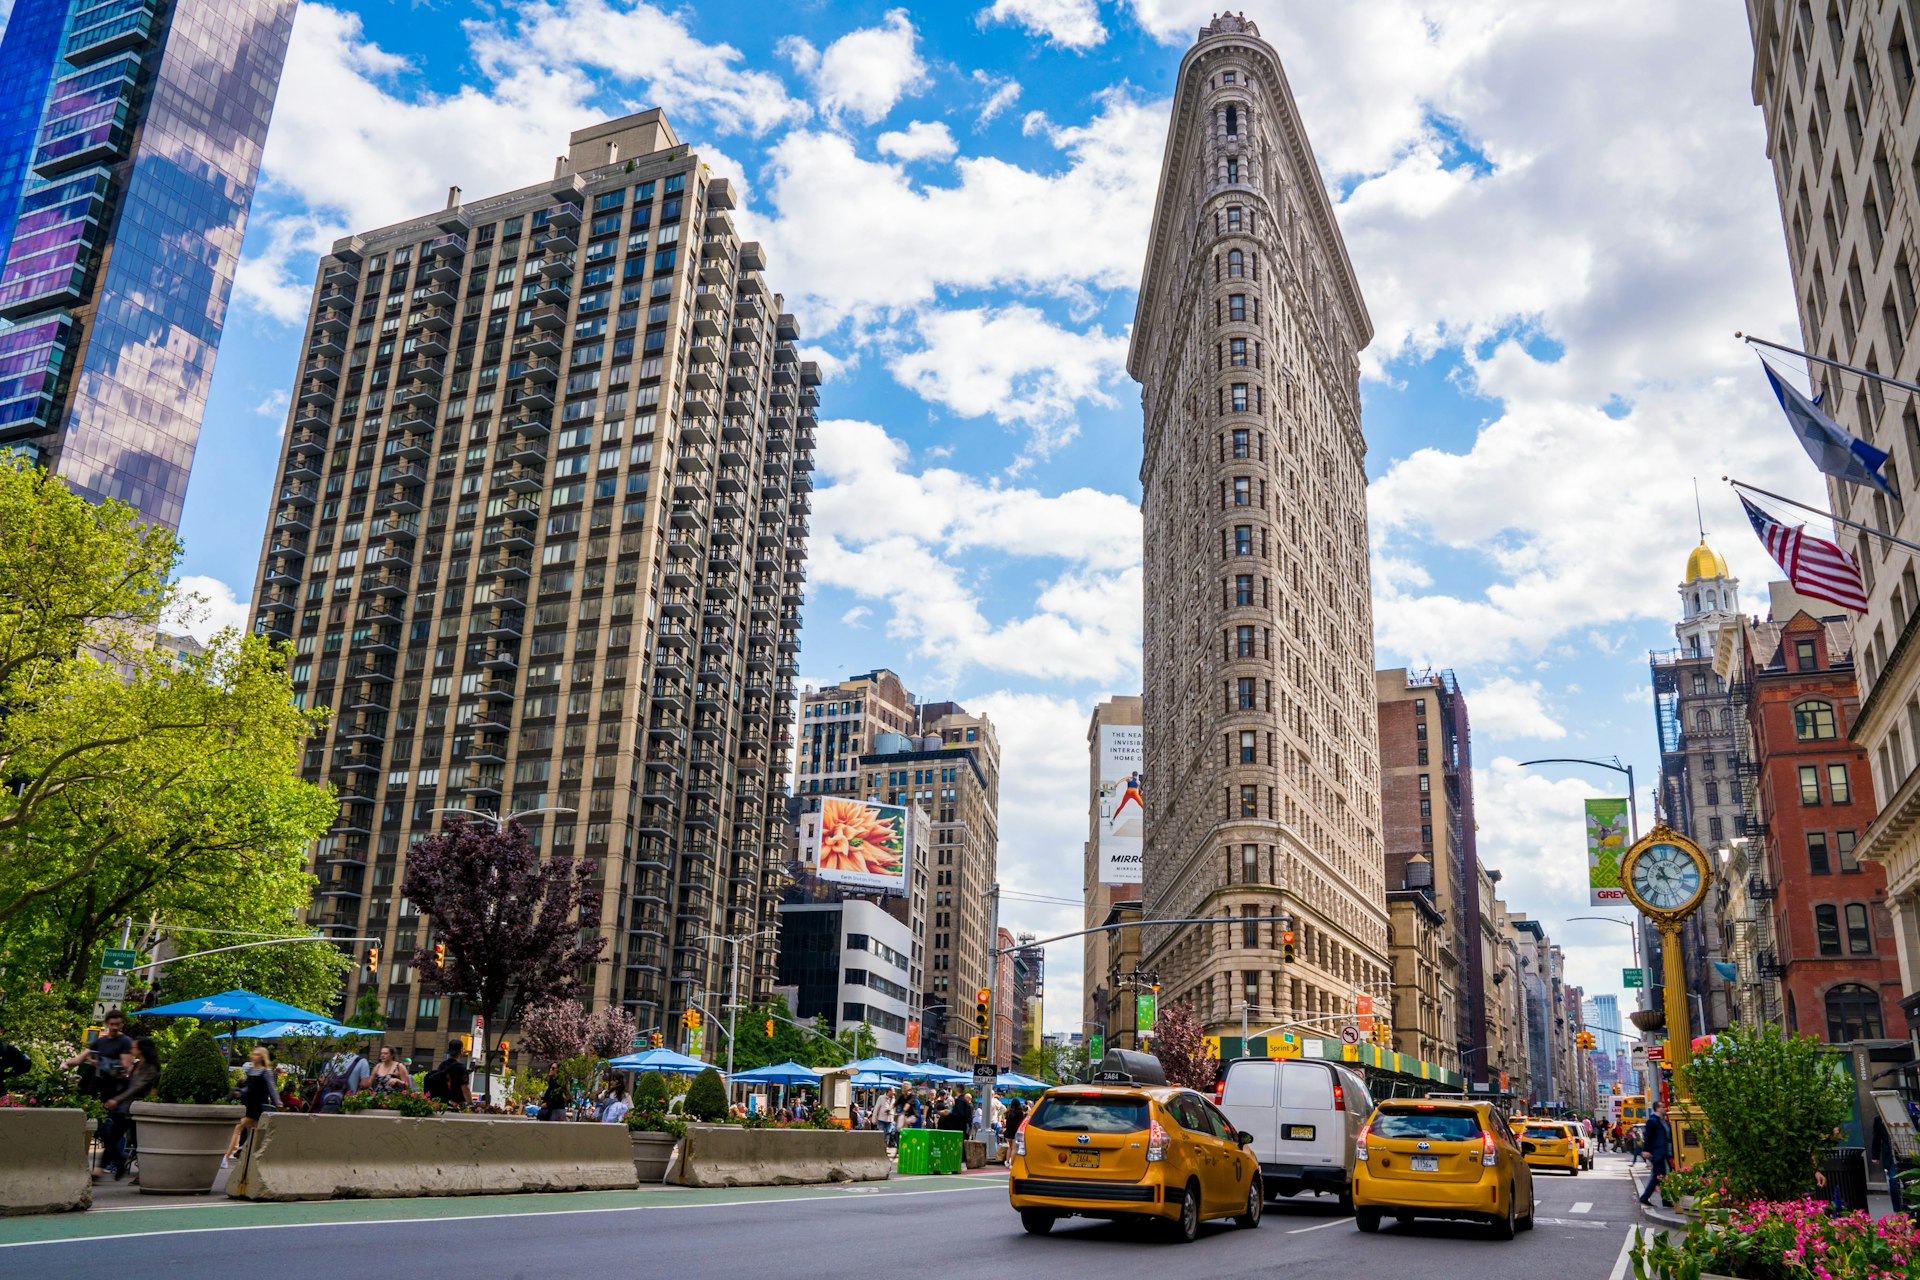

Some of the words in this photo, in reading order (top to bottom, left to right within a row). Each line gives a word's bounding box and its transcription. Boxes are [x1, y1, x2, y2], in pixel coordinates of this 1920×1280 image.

[1597, 890, 1626, 899] GREY
[1270, 1044, 1290, 1053] Sprint
[1103, 1072, 1119, 1080] 2A64
